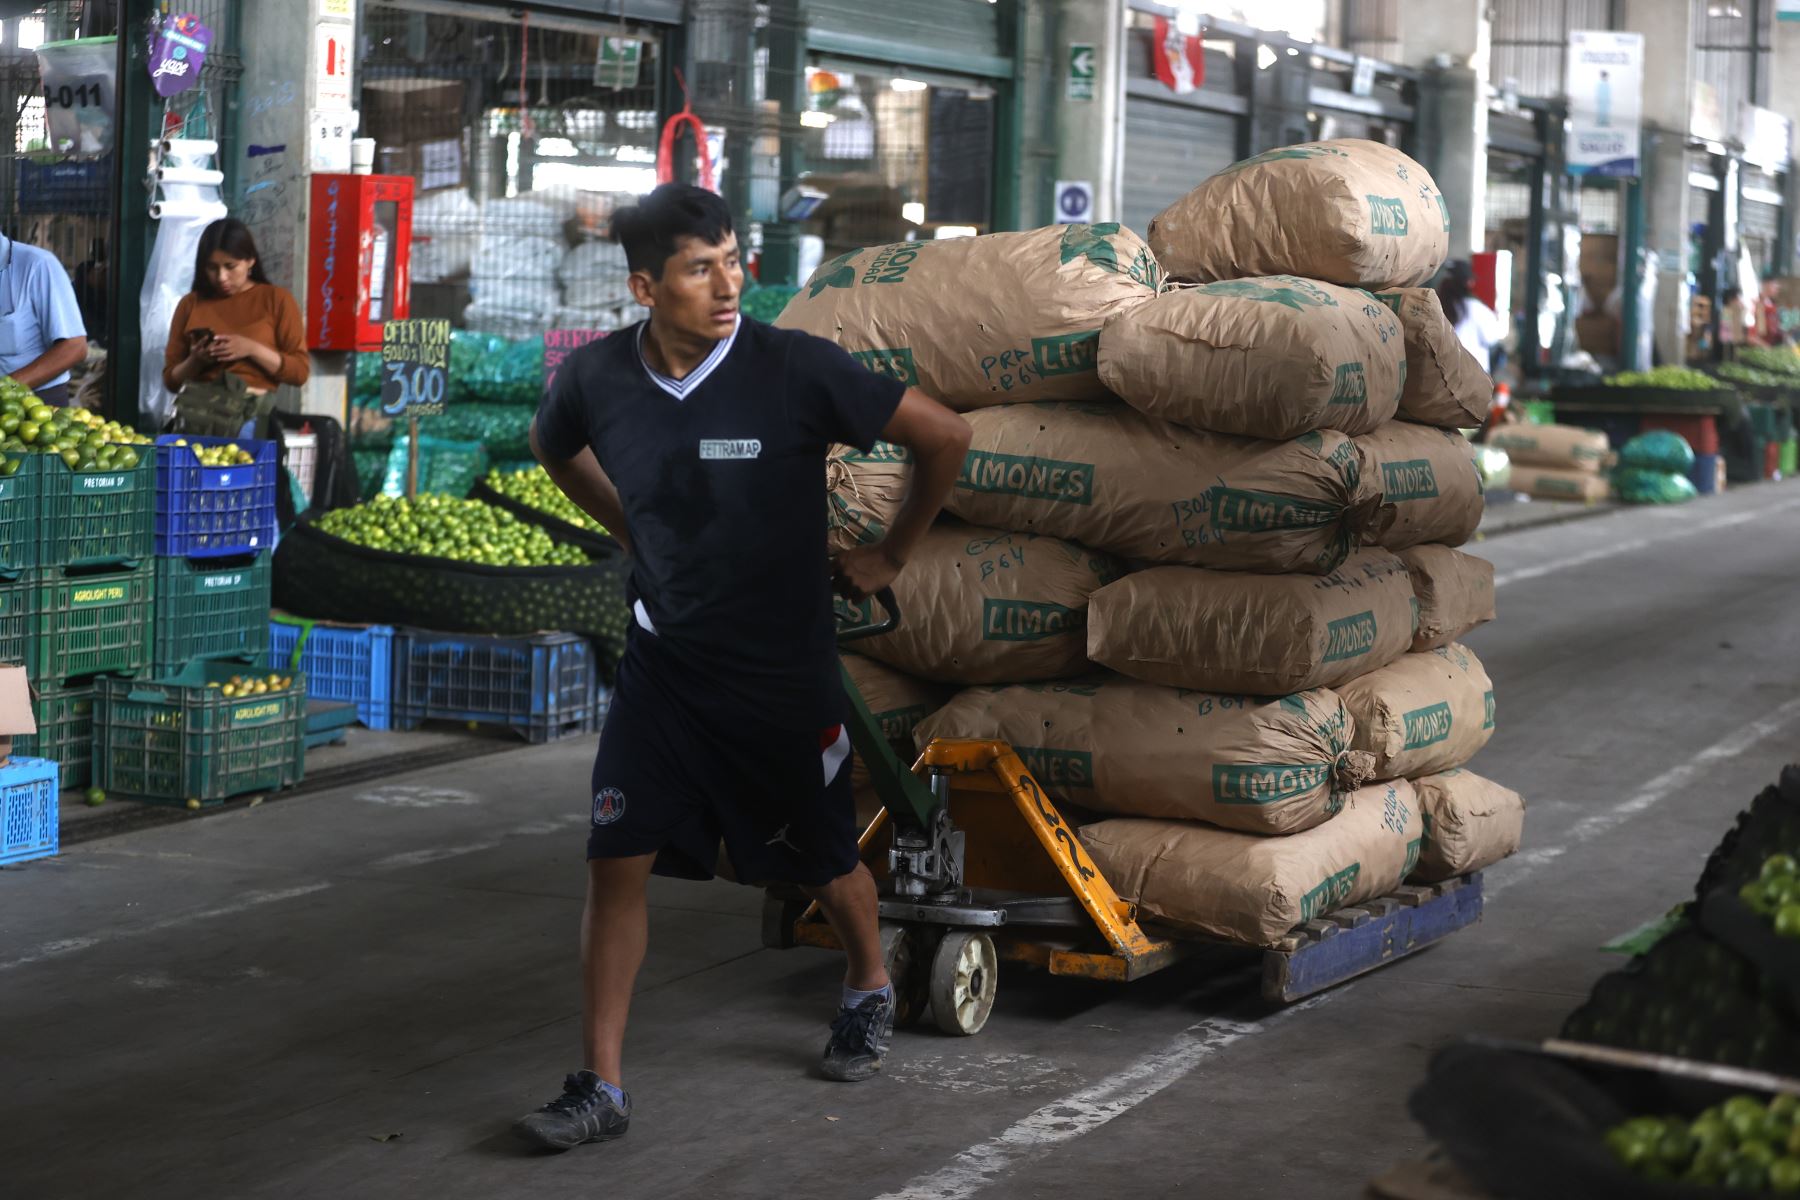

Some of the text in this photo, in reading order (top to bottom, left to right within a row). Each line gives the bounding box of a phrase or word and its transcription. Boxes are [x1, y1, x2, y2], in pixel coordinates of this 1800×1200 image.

[153, 58, 189, 77] yape
[84, 477, 115, 488] PRETORIAN
[957, 457, 1085, 497] IMONES
[108, 587, 124, 600] PERU
